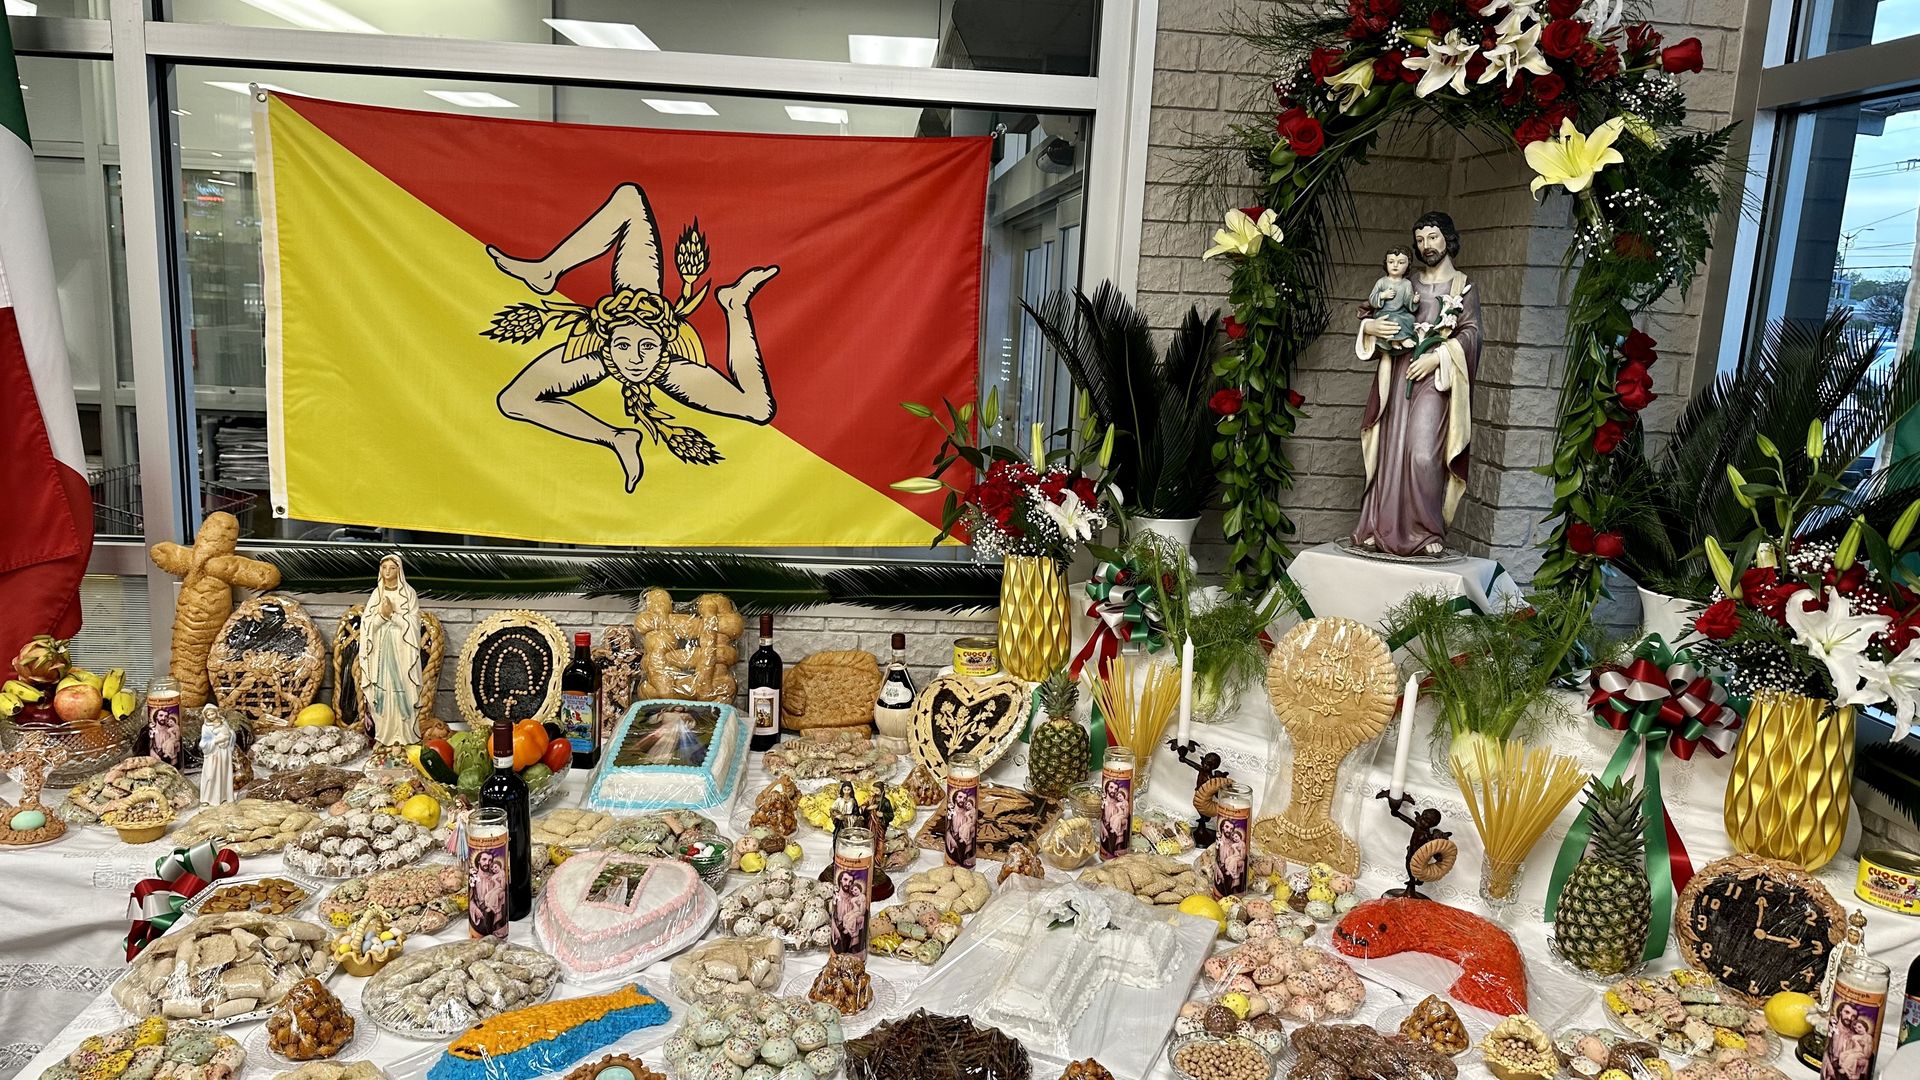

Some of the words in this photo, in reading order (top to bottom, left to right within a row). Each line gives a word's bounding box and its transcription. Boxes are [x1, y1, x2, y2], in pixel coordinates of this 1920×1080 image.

[1315, 672, 1345, 692] IHS
[1867, 866, 1908, 886] CUOCO
[1724, 883, 1743, 900] 11
[1755, 879, 1774, 892] 12
[1702, 895, 1721, 910] 10
[1697, 915, 1708, 931] 9
[1804, 910, 1818, 927] 2
[1701, 942, 1713, 959] 8
[1811, 940, 1823, 955] 3
[1722, 965, 1734, 978] 7
[1847, 988, 1871, 999] Joseph
